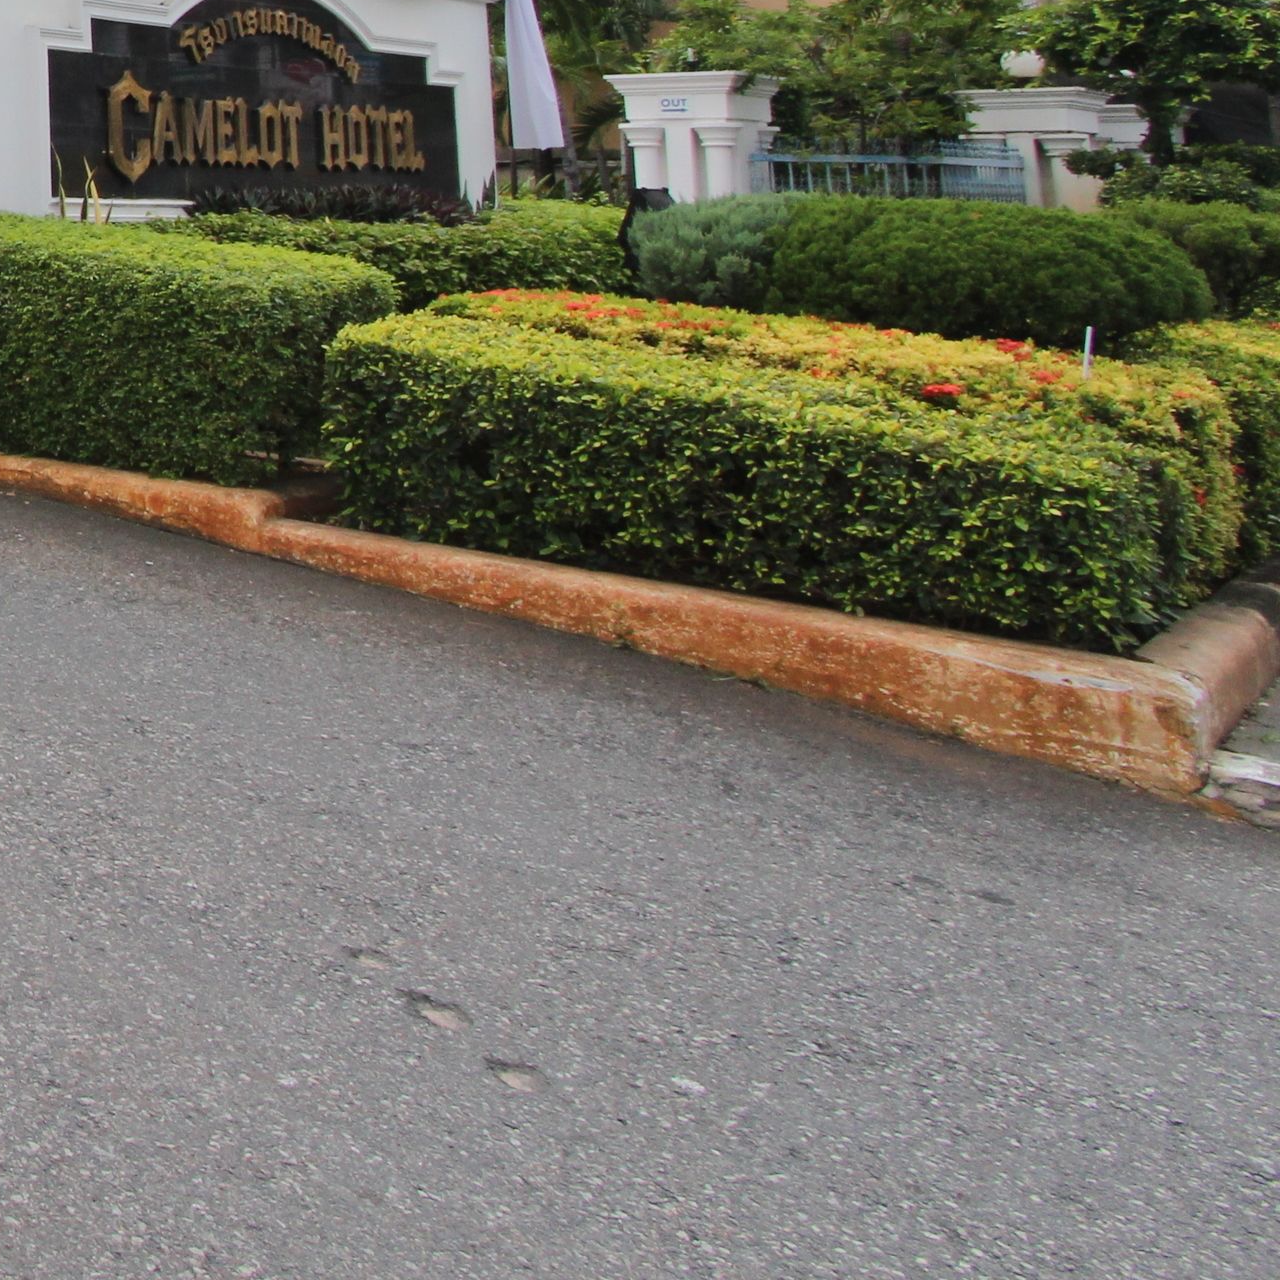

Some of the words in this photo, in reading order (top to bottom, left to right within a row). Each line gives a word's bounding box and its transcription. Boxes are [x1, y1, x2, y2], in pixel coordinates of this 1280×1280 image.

[108, 70, 303, 183] CAMELOT
[319, 104, 425, 171] HOTEL
[661, 99, 688, 107] OUT
